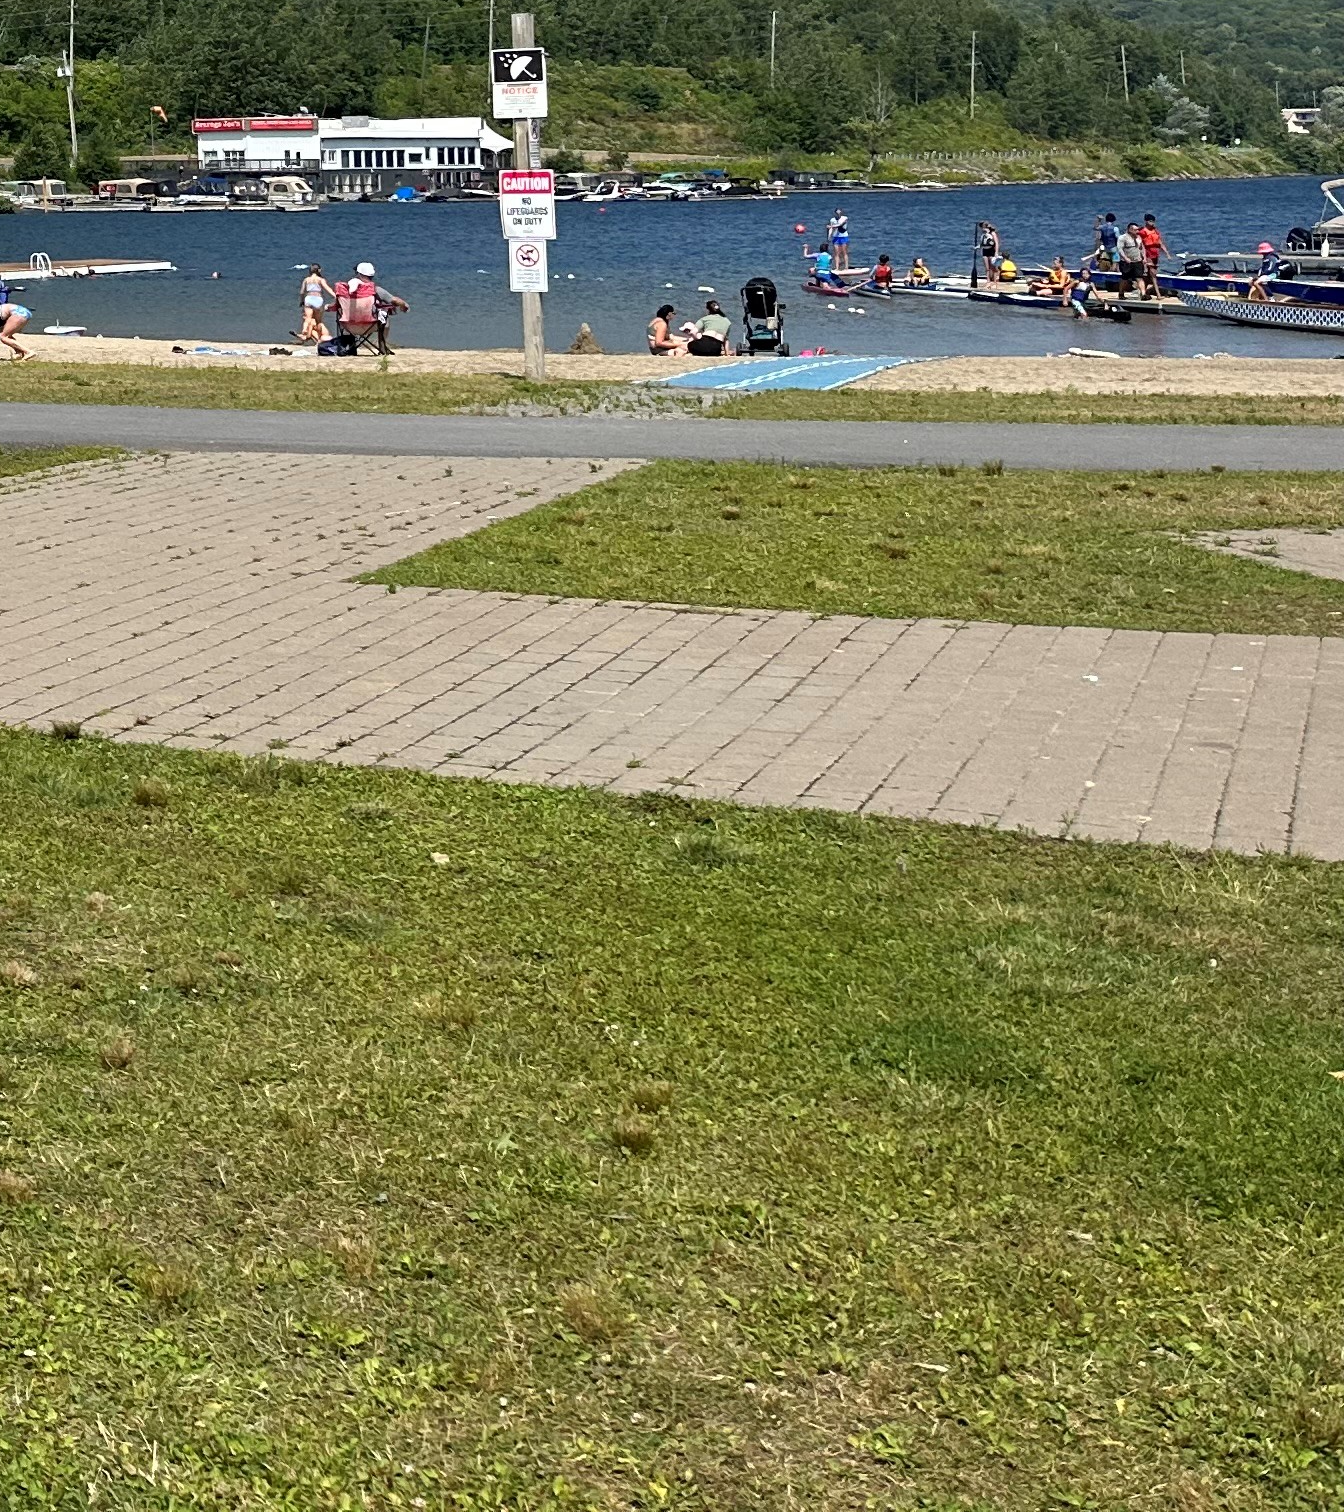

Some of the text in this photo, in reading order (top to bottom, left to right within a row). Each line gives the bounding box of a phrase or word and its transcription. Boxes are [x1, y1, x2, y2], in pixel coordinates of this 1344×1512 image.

[502, 87, 538, 95] NOTICE
[503, 177, 549, 191] CAUTION
[507, 207, 548, 216] LIFEGUARDS
[512, 217, 543, 226] ON DUTY
